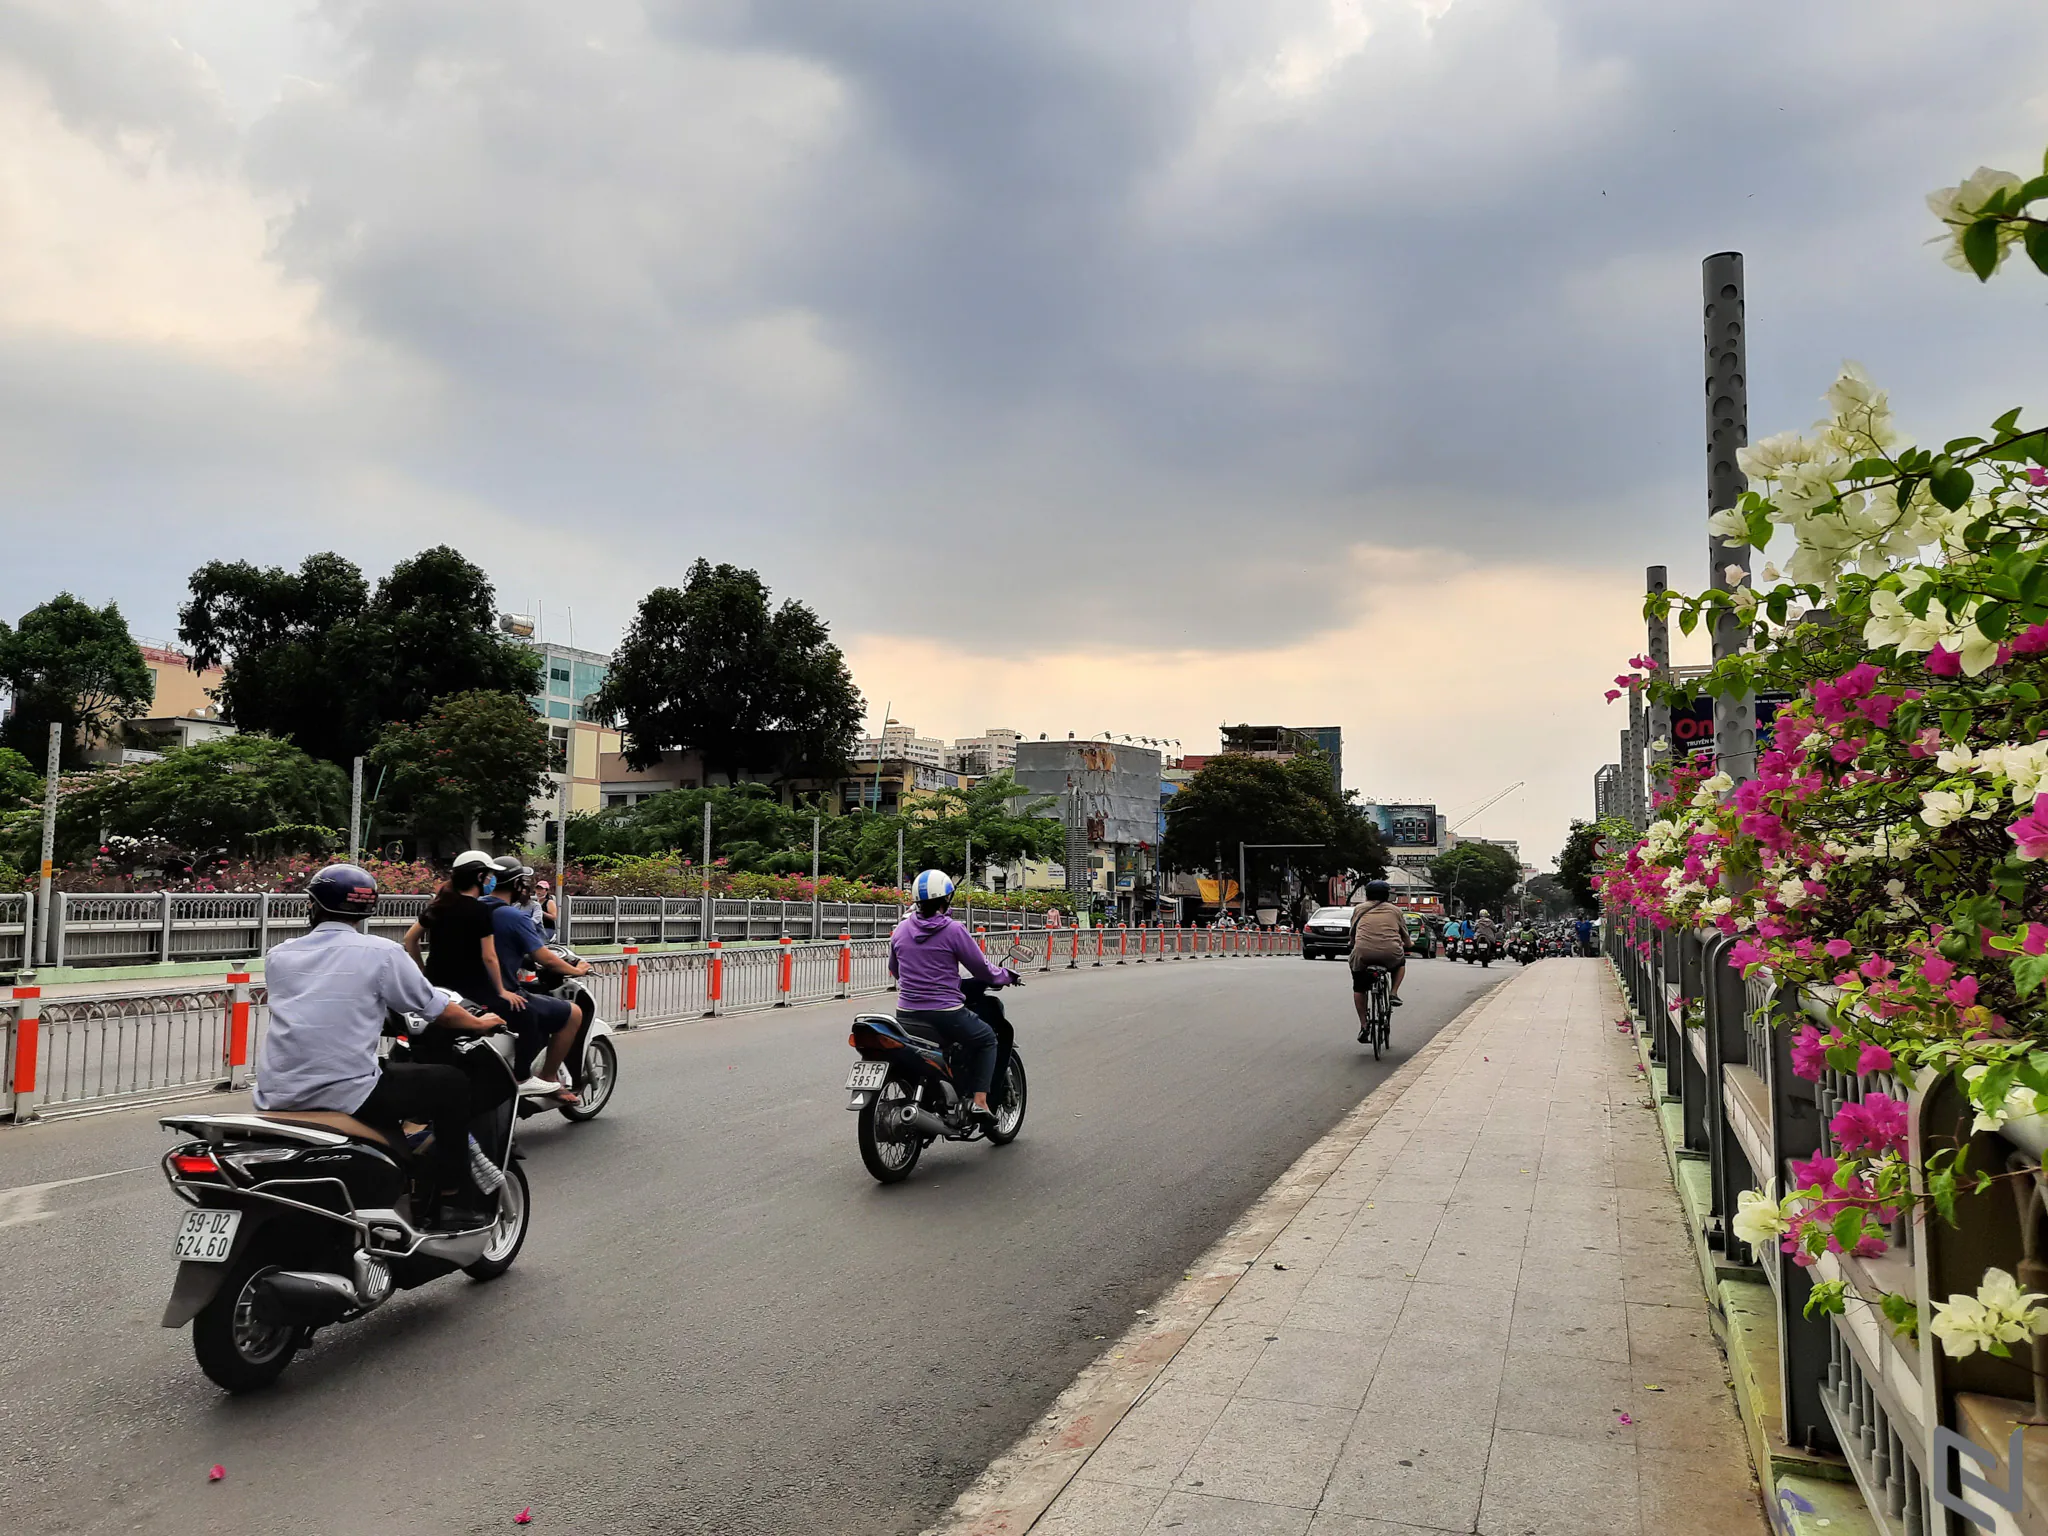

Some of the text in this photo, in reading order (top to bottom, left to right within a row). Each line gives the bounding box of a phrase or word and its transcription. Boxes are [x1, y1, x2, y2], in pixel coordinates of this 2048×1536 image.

[851, 1075, 877, 1087] 5851
[186, 1213, 231, 1234] 59-D2
[175, 1235, 229, 1258] 624.60
